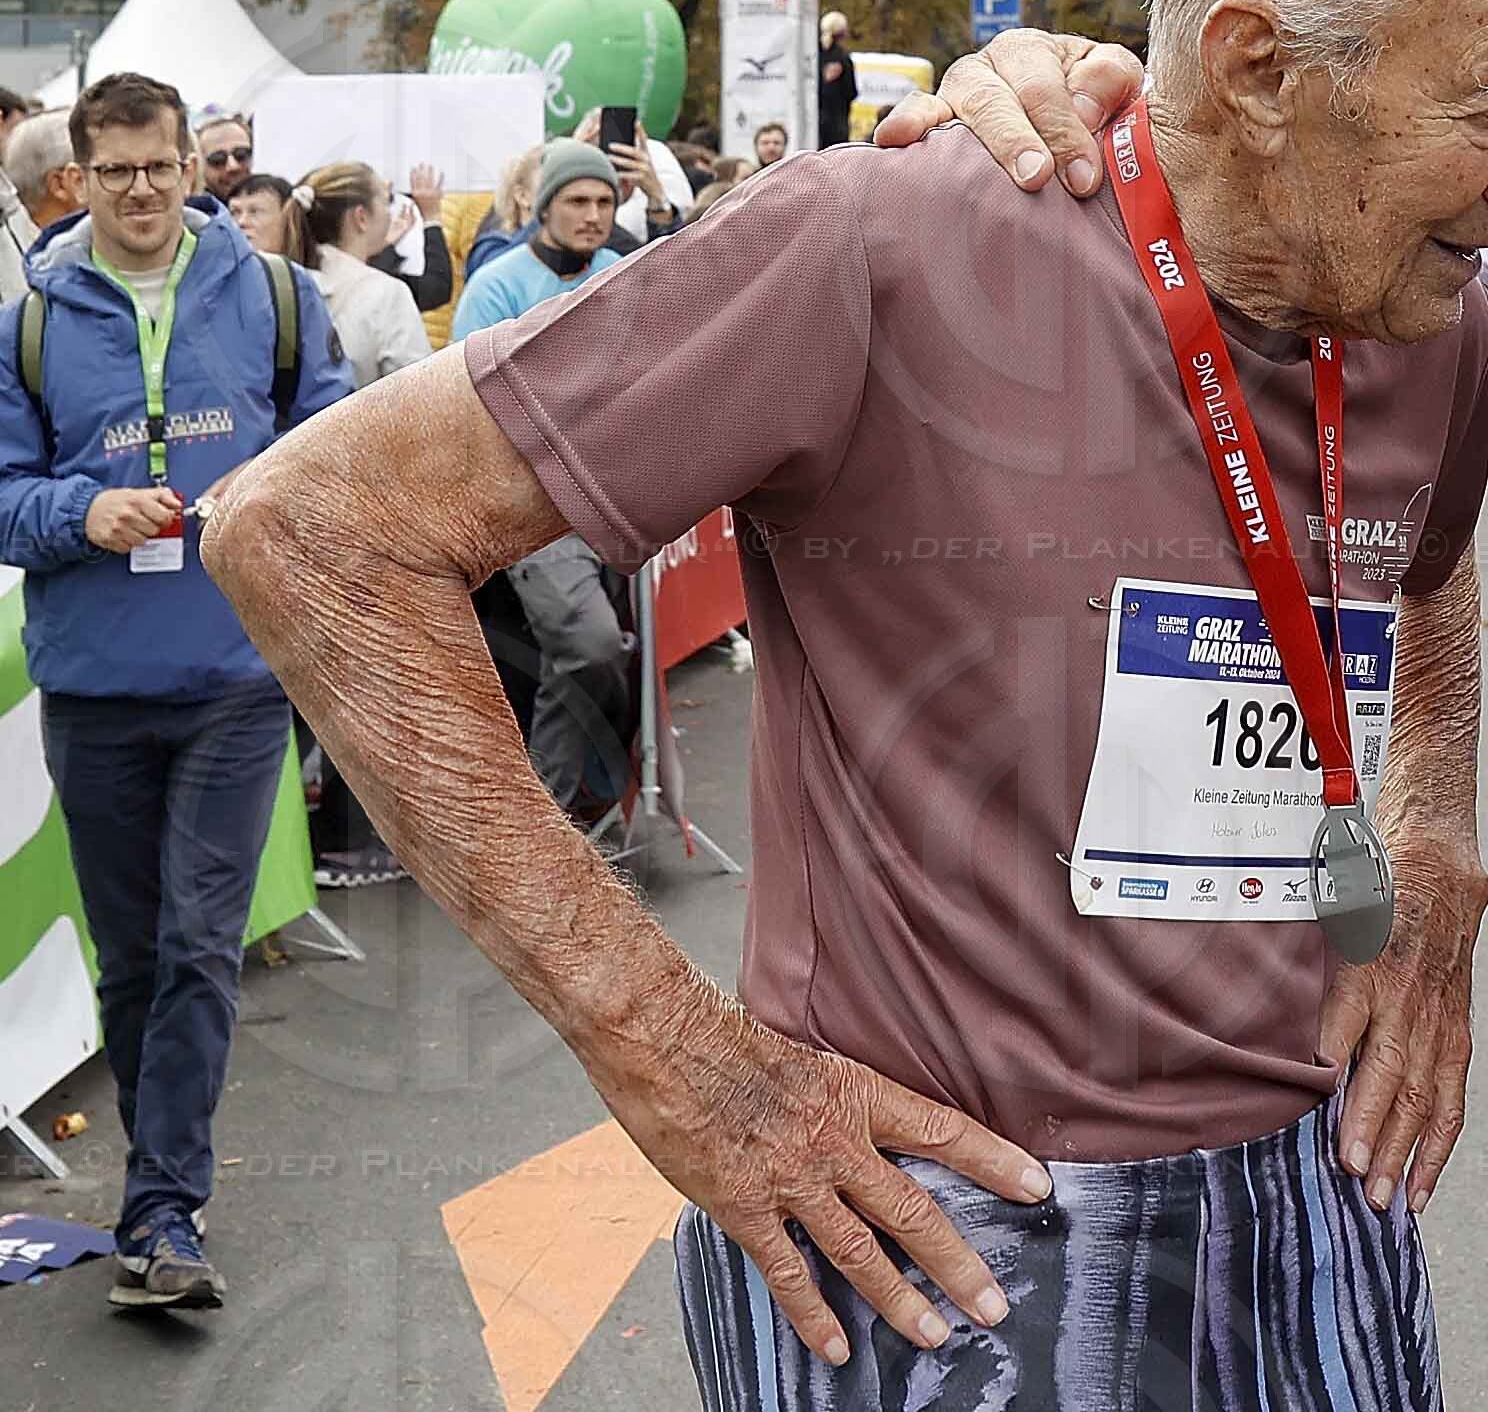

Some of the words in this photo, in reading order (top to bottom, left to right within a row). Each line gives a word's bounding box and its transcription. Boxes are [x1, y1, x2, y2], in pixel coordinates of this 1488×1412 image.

[1147, 238, 1185, 291] 2024
[1318, 336, 1332, 361] 20
[1192, 351, 1239, 447] ZEITUNG
[1324, 424, 1337, 517] ZEITUNG
[1225, 449, 1270, 545] KLEINE
[1341, 517, 1398, 547] GRAZ
[1339, 550, 1381, 565] RATHON
[1362, 567, 1387, 581] 2023
[1156, 624, 1189, 635] ZEITUNG
[1157, 614, 1189, 626] KLEINE
[1195, 616, 1245, 642] GRAZ
[1187, 639, 1282, 668] MARATHON
[1343, 654, 1378, 676] RAZ
[1194, 788, 1229, 805] Kleine
[1231, 789, 1271, 809] Zeitung
[1272, 791, 1323, 807] Marathon
[1190, 895, 1218, 903] HYUNDAI
